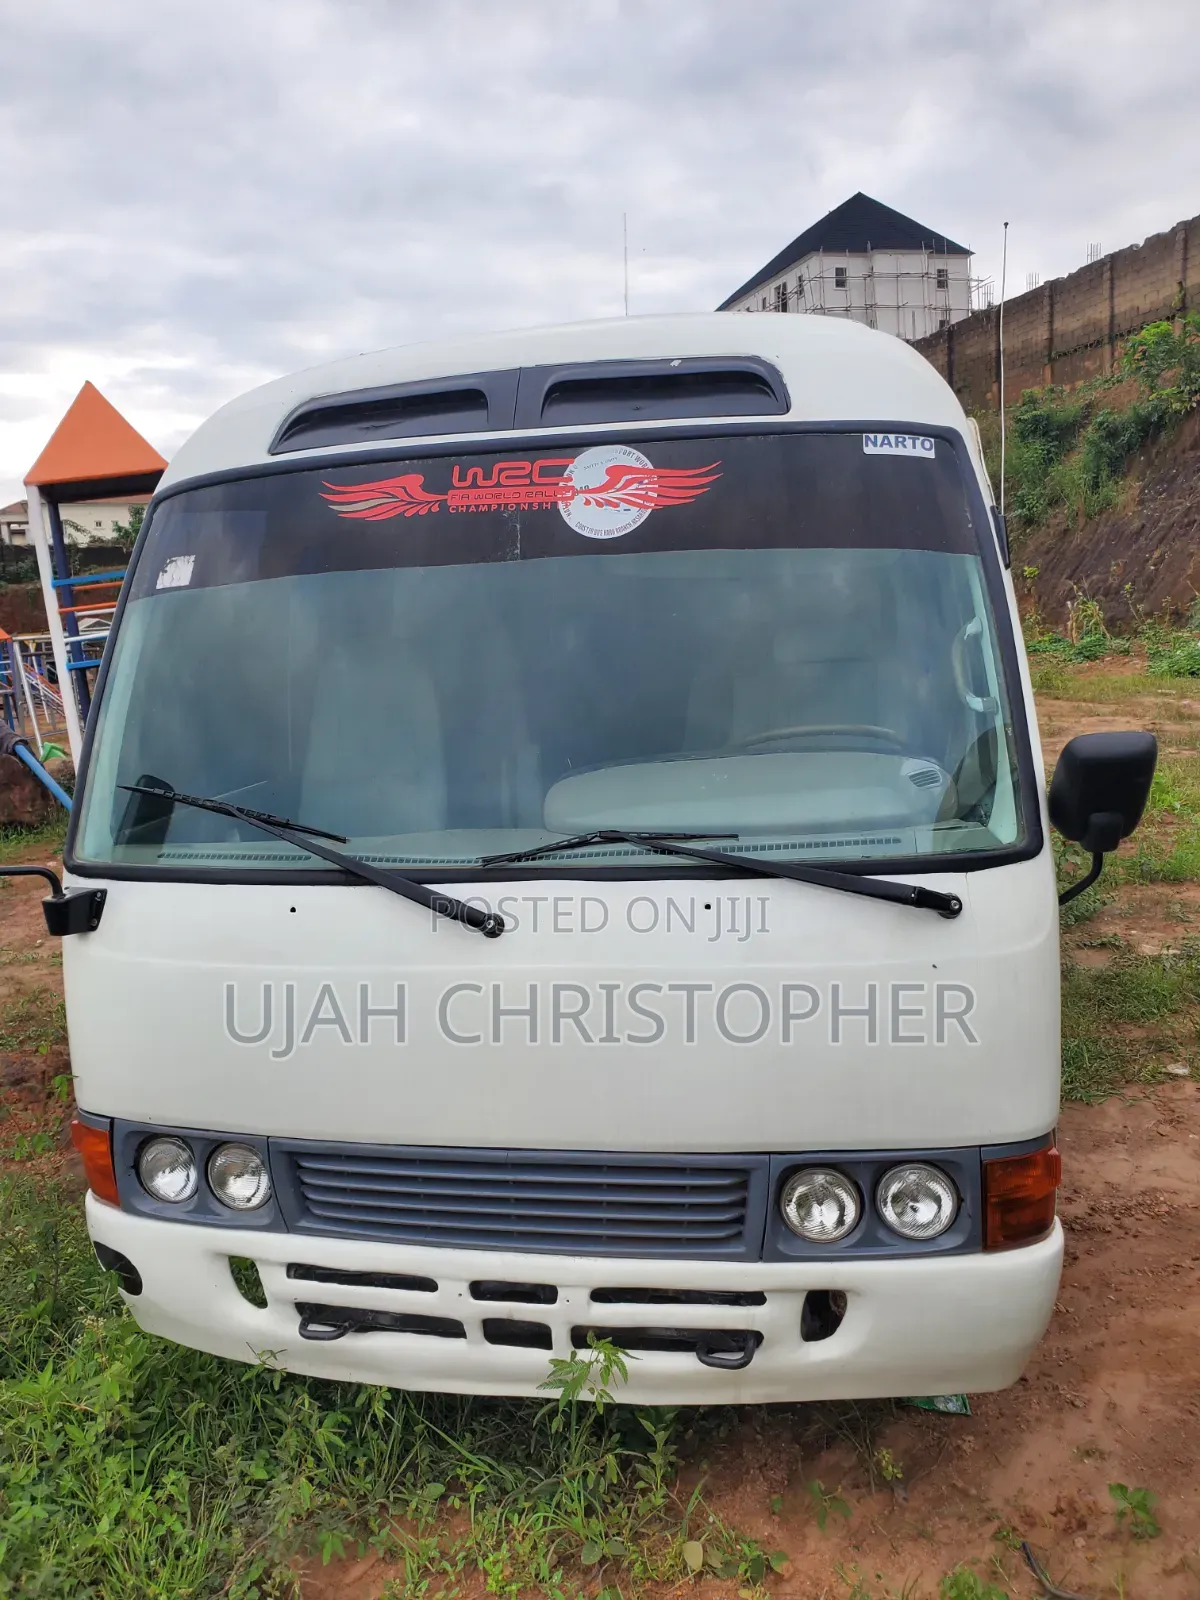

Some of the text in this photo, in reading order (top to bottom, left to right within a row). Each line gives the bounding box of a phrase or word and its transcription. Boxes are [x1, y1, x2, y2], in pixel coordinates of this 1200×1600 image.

[865, 435, 933, 451] NARTO
[452, 458, 574, 487] WRC
[474, 492, 521, 500] WORLD
